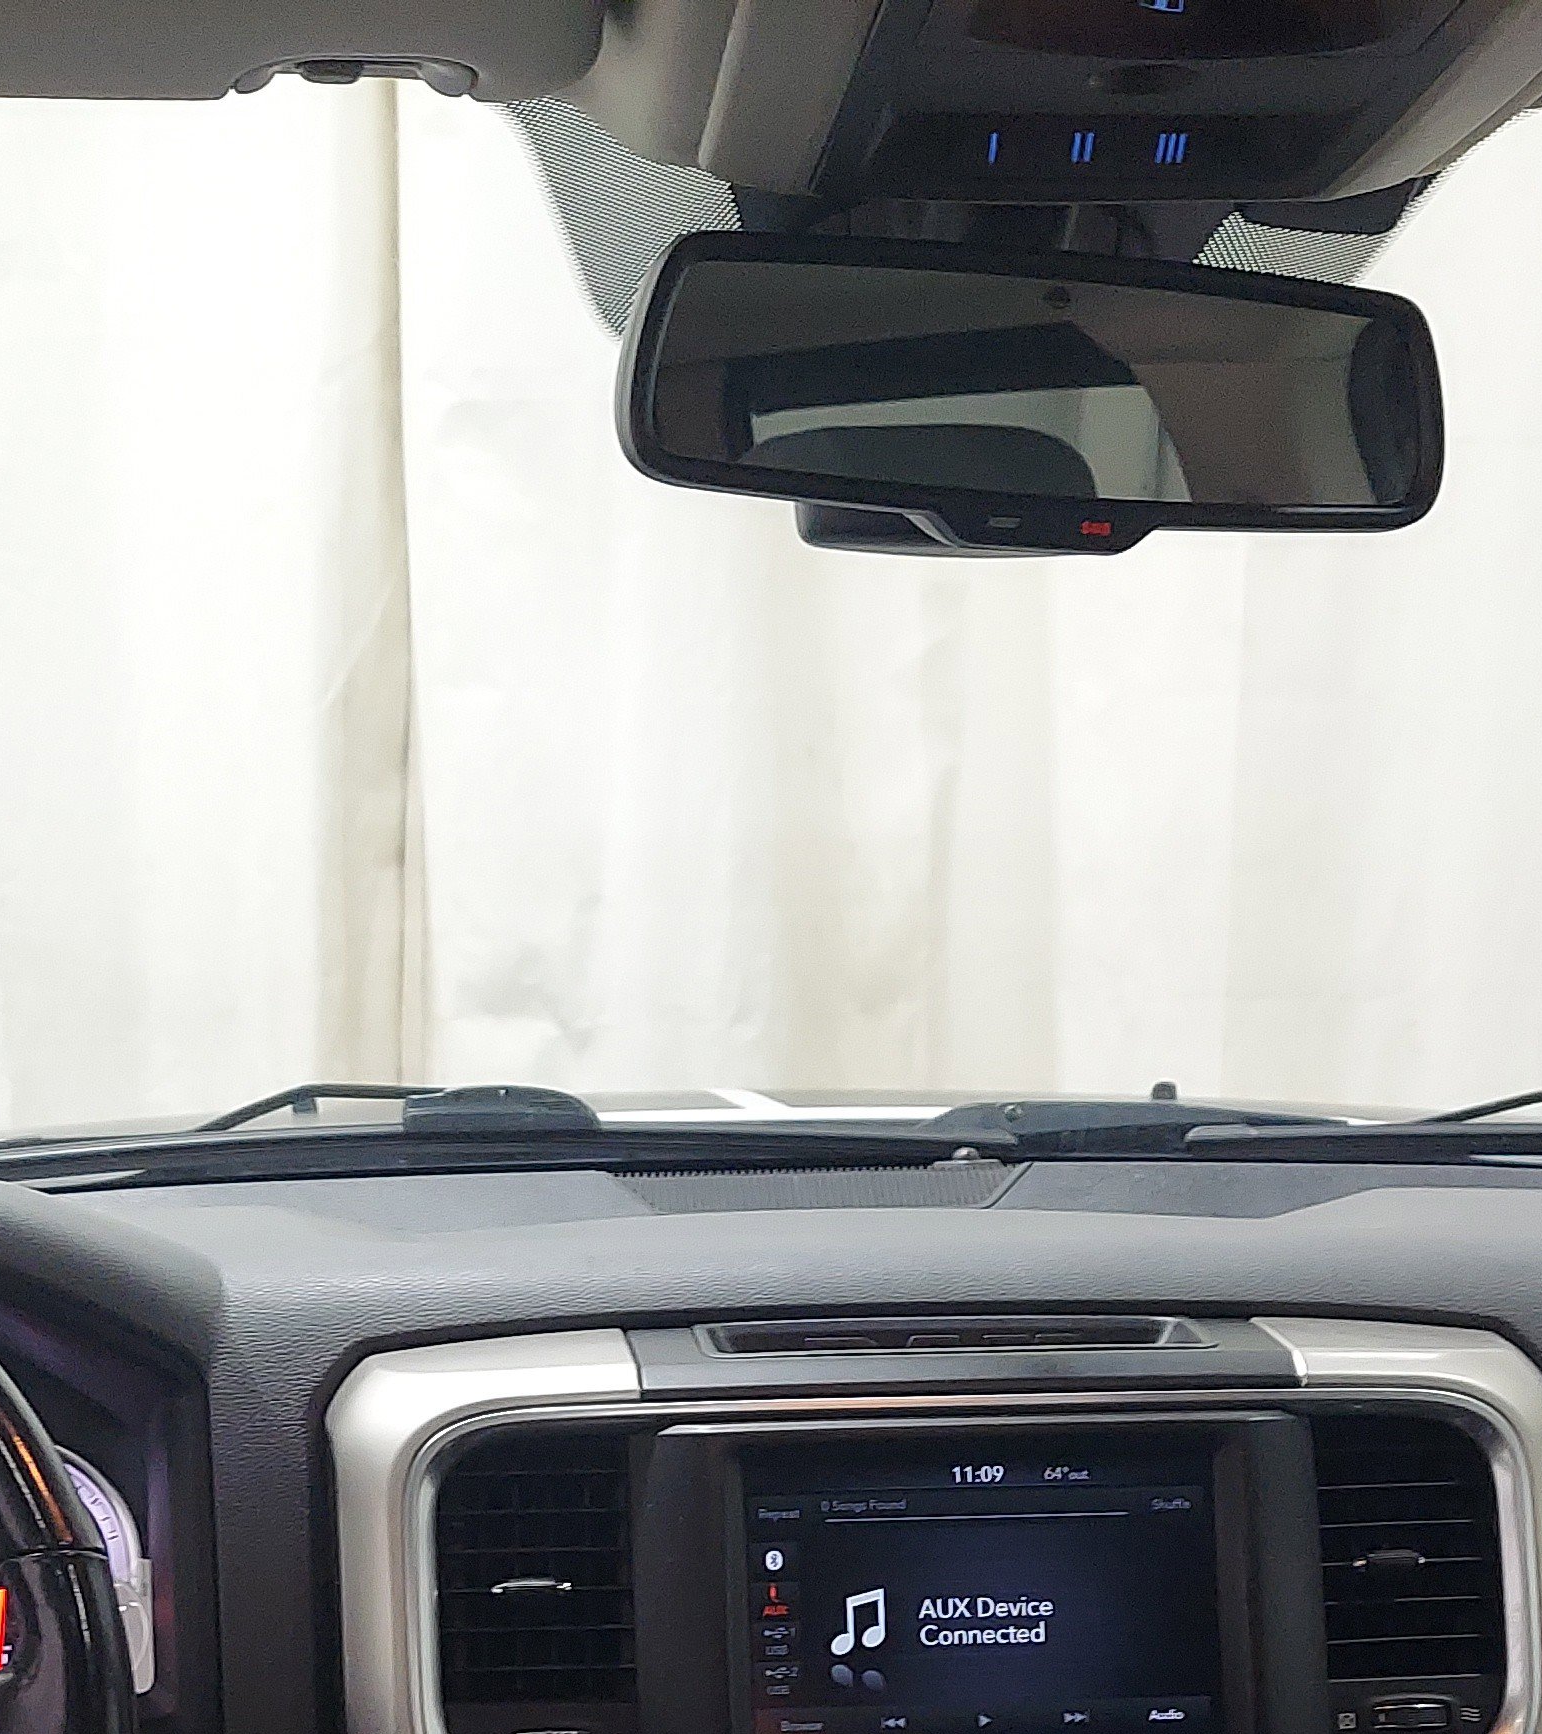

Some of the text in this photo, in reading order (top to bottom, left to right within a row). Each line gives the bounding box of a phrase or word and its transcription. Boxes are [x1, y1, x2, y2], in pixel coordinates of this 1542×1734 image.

[952, 1466, 1005, 1484] 11:09
[918, 1596, 1055, 1620] AUX Device
[919, 1620, 1047, 1646] Connected
